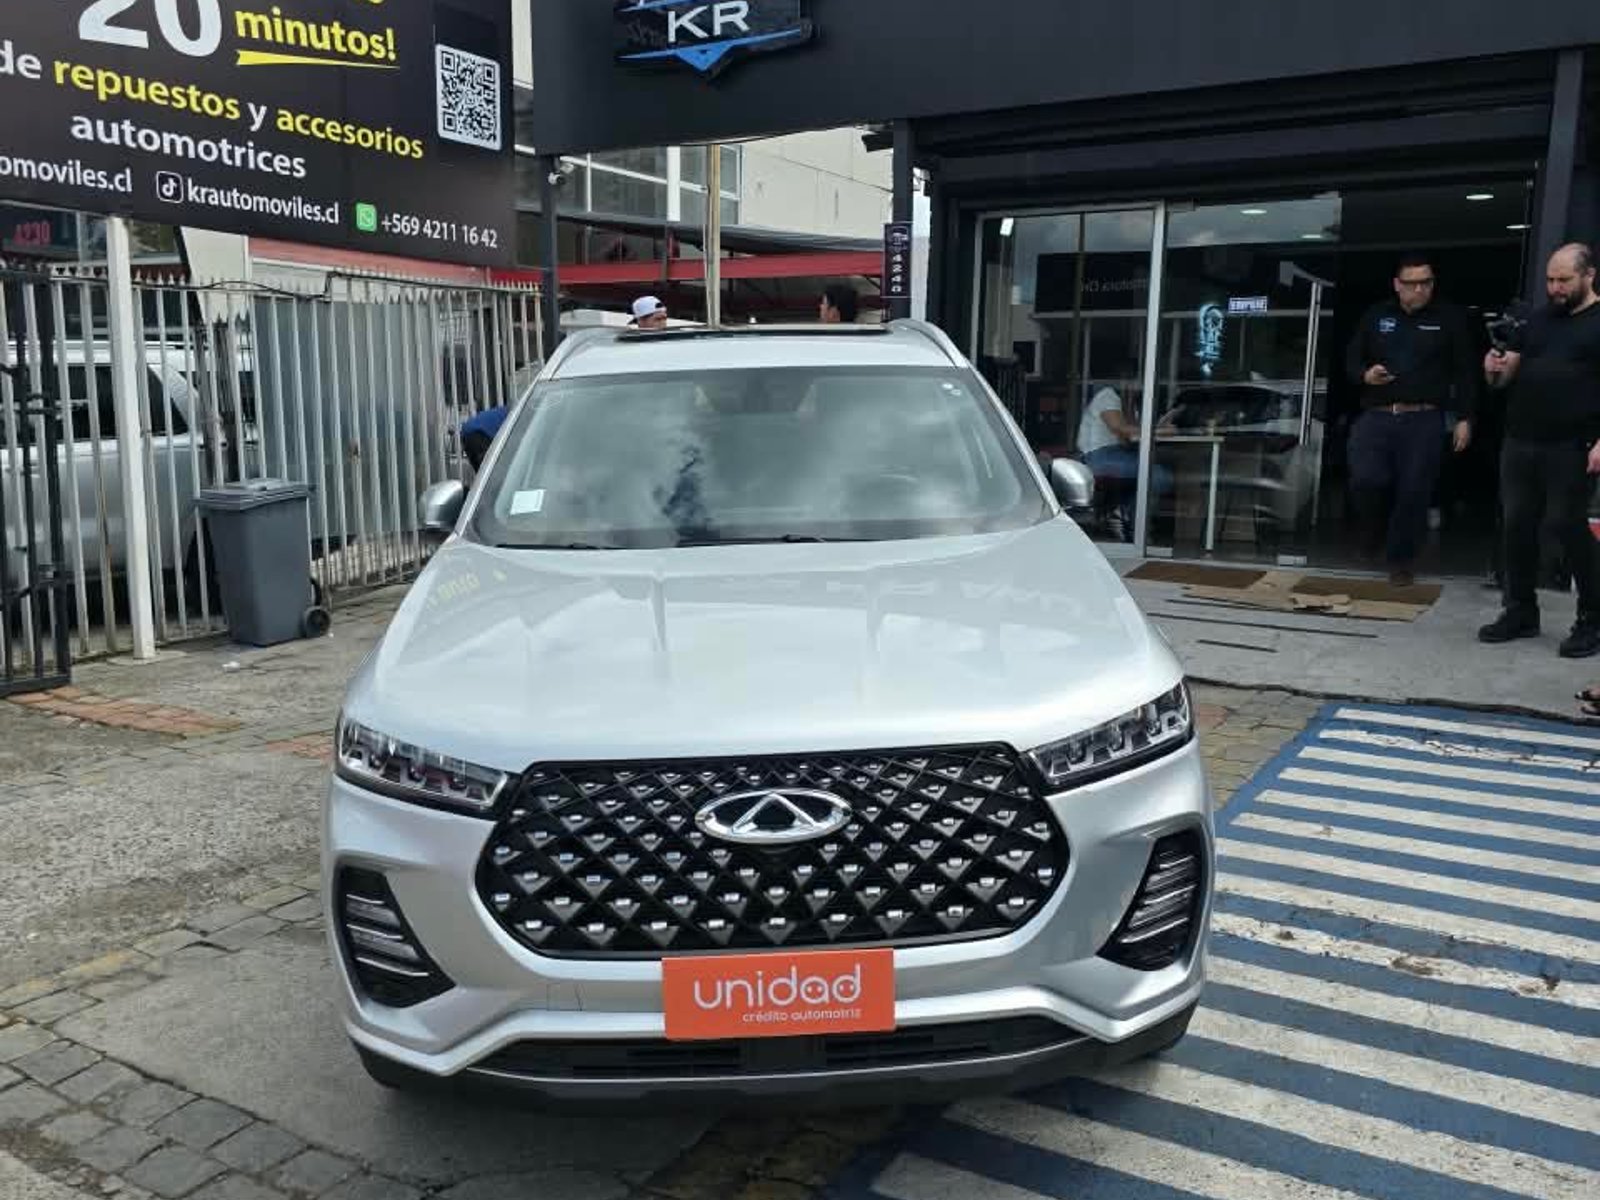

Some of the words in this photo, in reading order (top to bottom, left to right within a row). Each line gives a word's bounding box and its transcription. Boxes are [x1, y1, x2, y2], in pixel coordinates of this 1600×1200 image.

[235, 6, 396, 61] minutos!
[667, 0, 750, 42] KR
[53, 60, 241, 120] repuestos
[247, 102, 267, 132] y
[276, 108, 424, 159] accesorios
[70, 115, 306, 178] automotrices
[187, 178, 340, 225] krautomoviles.cl
[381, 213, 419, 236] +569
[423, 219, 456, 242] 4211
[694, 963, 862, 1010] unidad
